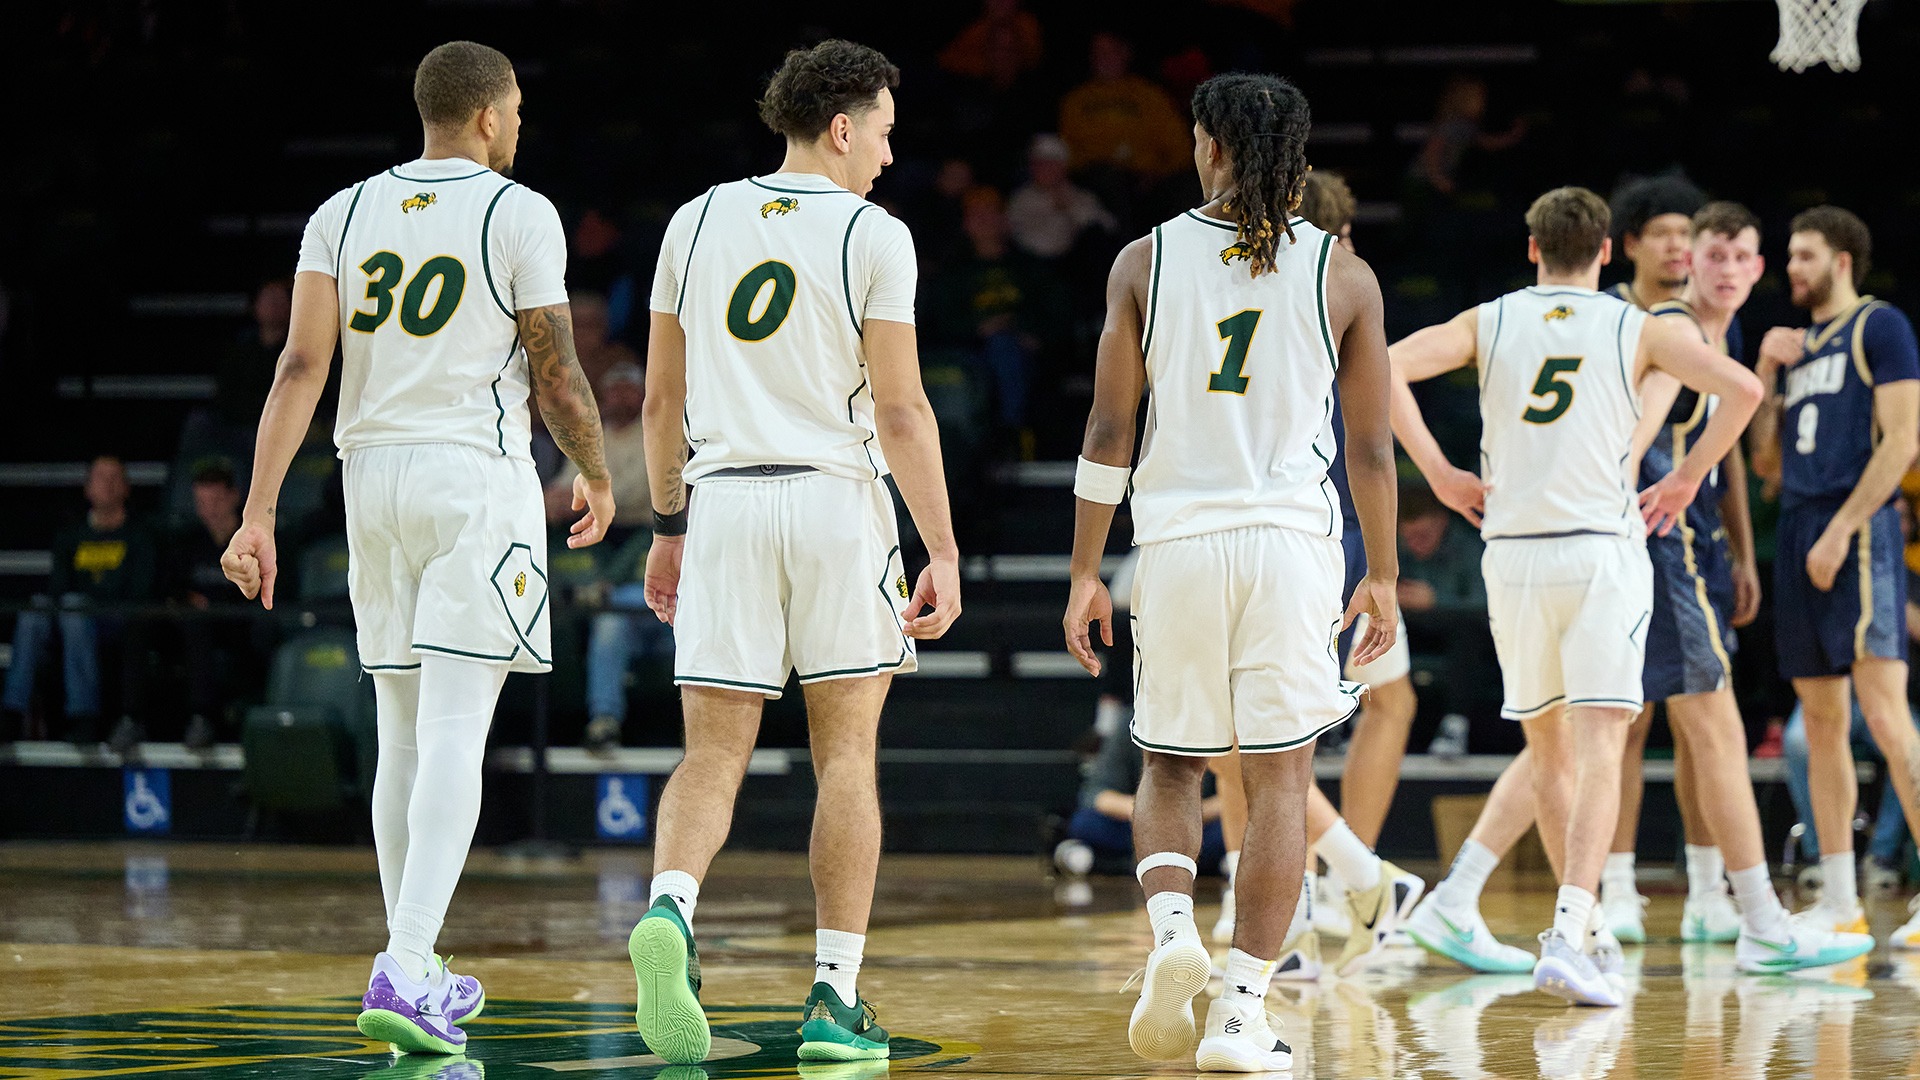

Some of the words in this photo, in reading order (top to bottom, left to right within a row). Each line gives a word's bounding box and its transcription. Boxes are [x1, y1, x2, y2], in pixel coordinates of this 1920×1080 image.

[348, 249, 467, 338] 30
[725, 258, 798, 342] 0
[1206, 307, 1264, 396] 1
[1520, 354, 1585, 427] 5
[1795, 402, 1819, 455] 9
